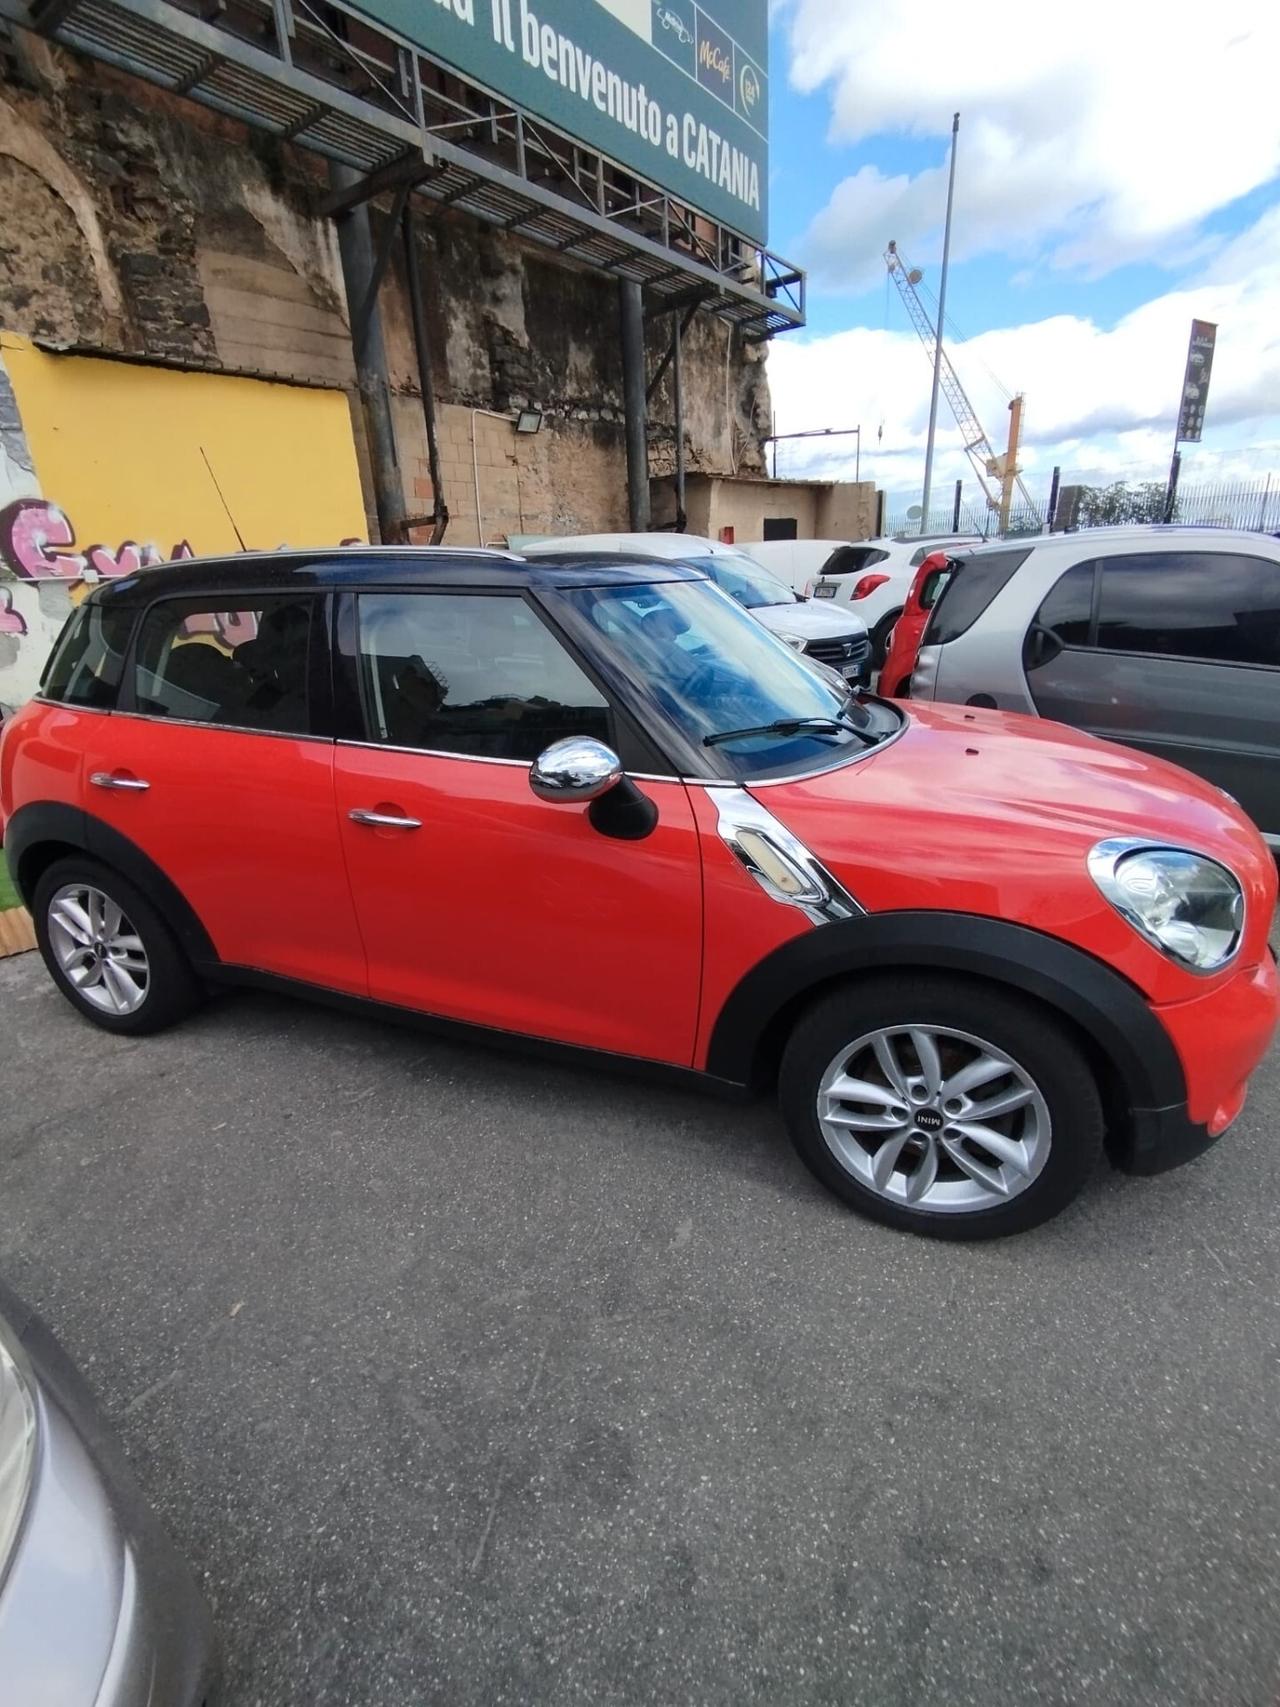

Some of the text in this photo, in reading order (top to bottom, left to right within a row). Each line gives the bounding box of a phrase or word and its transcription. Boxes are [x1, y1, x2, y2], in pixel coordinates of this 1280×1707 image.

[520, 0, 661, 146] benvenuto
[666, 113, 679, 159] a
[682, 112, 760, 211] CATANIA
[917, 1115, 941, 1126] MINI
